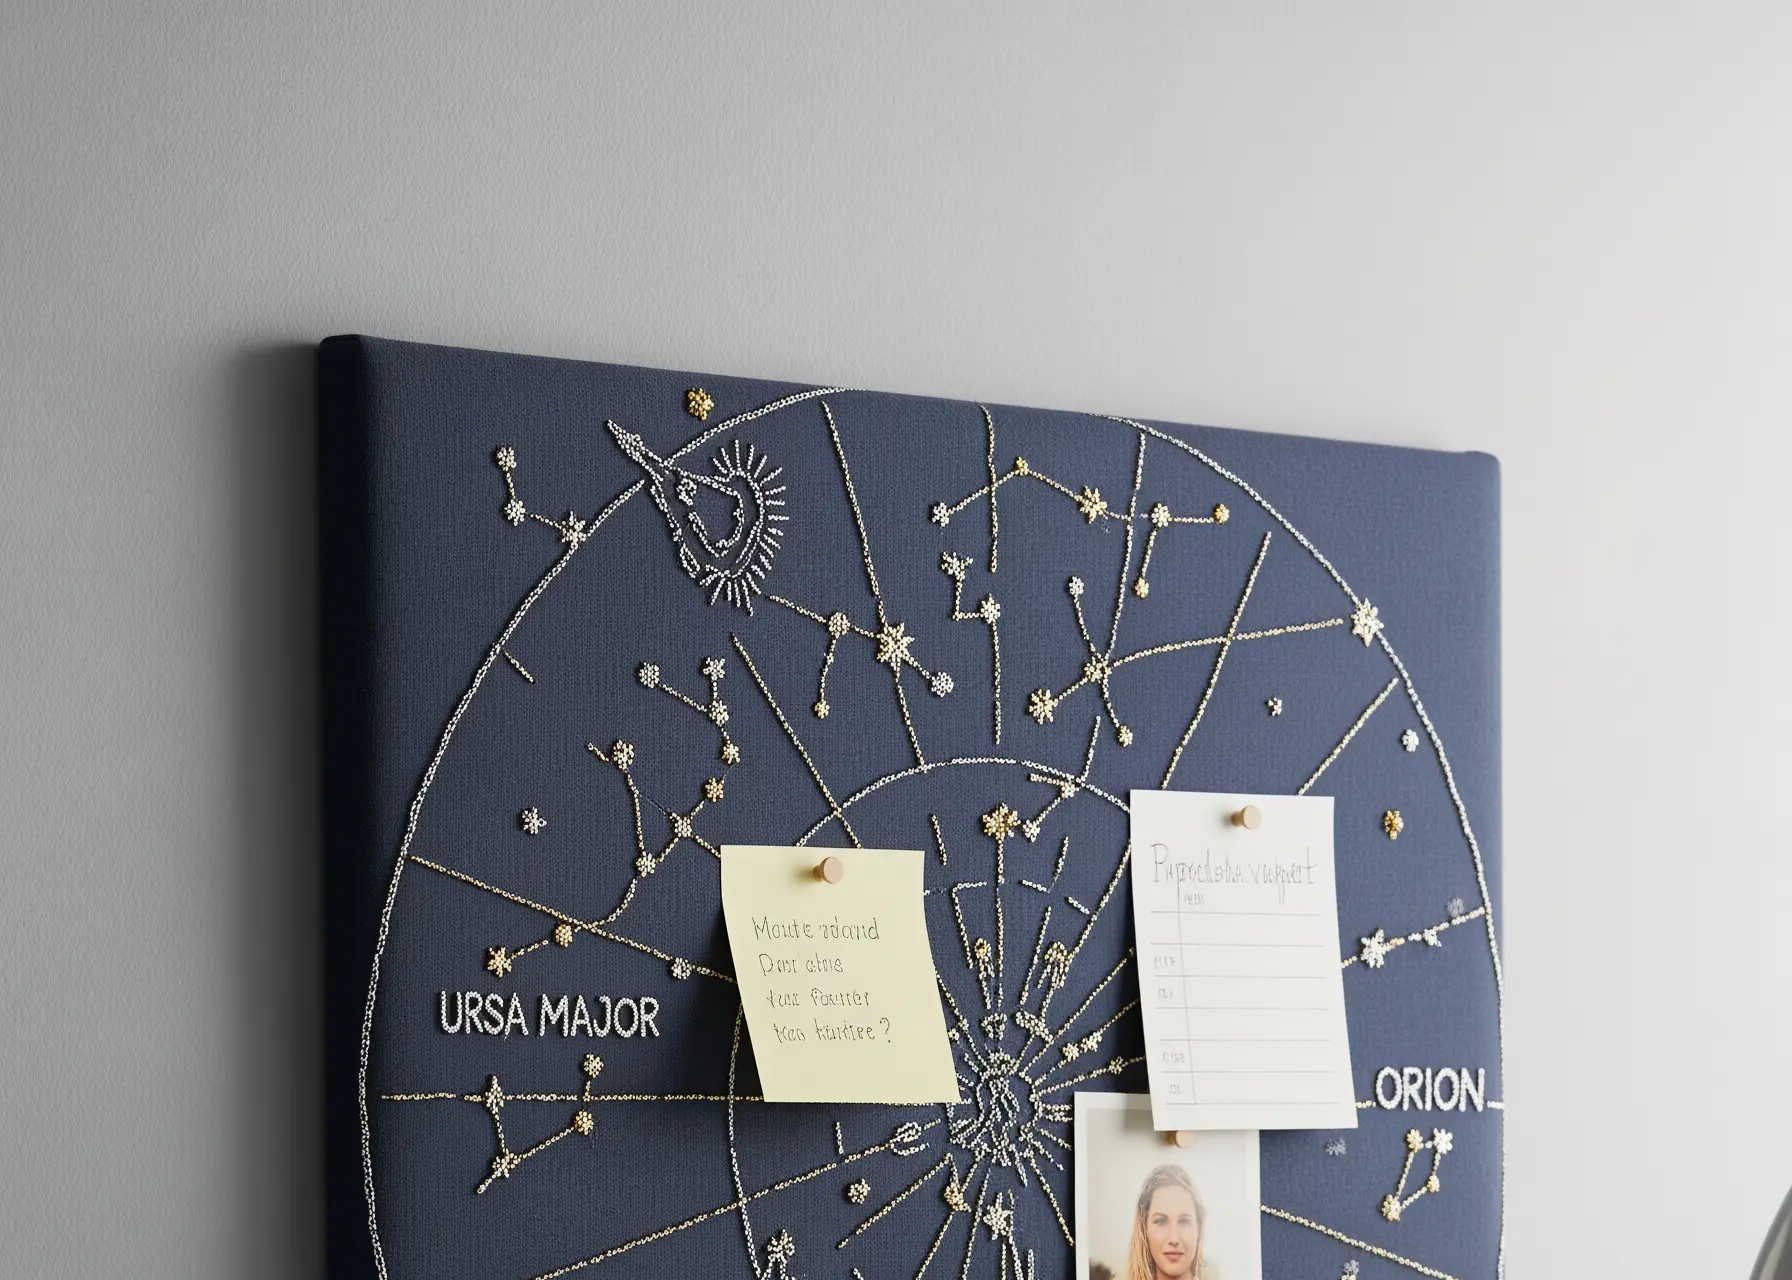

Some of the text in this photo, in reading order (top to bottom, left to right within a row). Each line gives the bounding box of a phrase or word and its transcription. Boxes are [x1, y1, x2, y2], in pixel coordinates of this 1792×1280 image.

[440, 990, 660, 1038] URSA MAJOR
[1376, 1066, 1486, 1112] ORION
